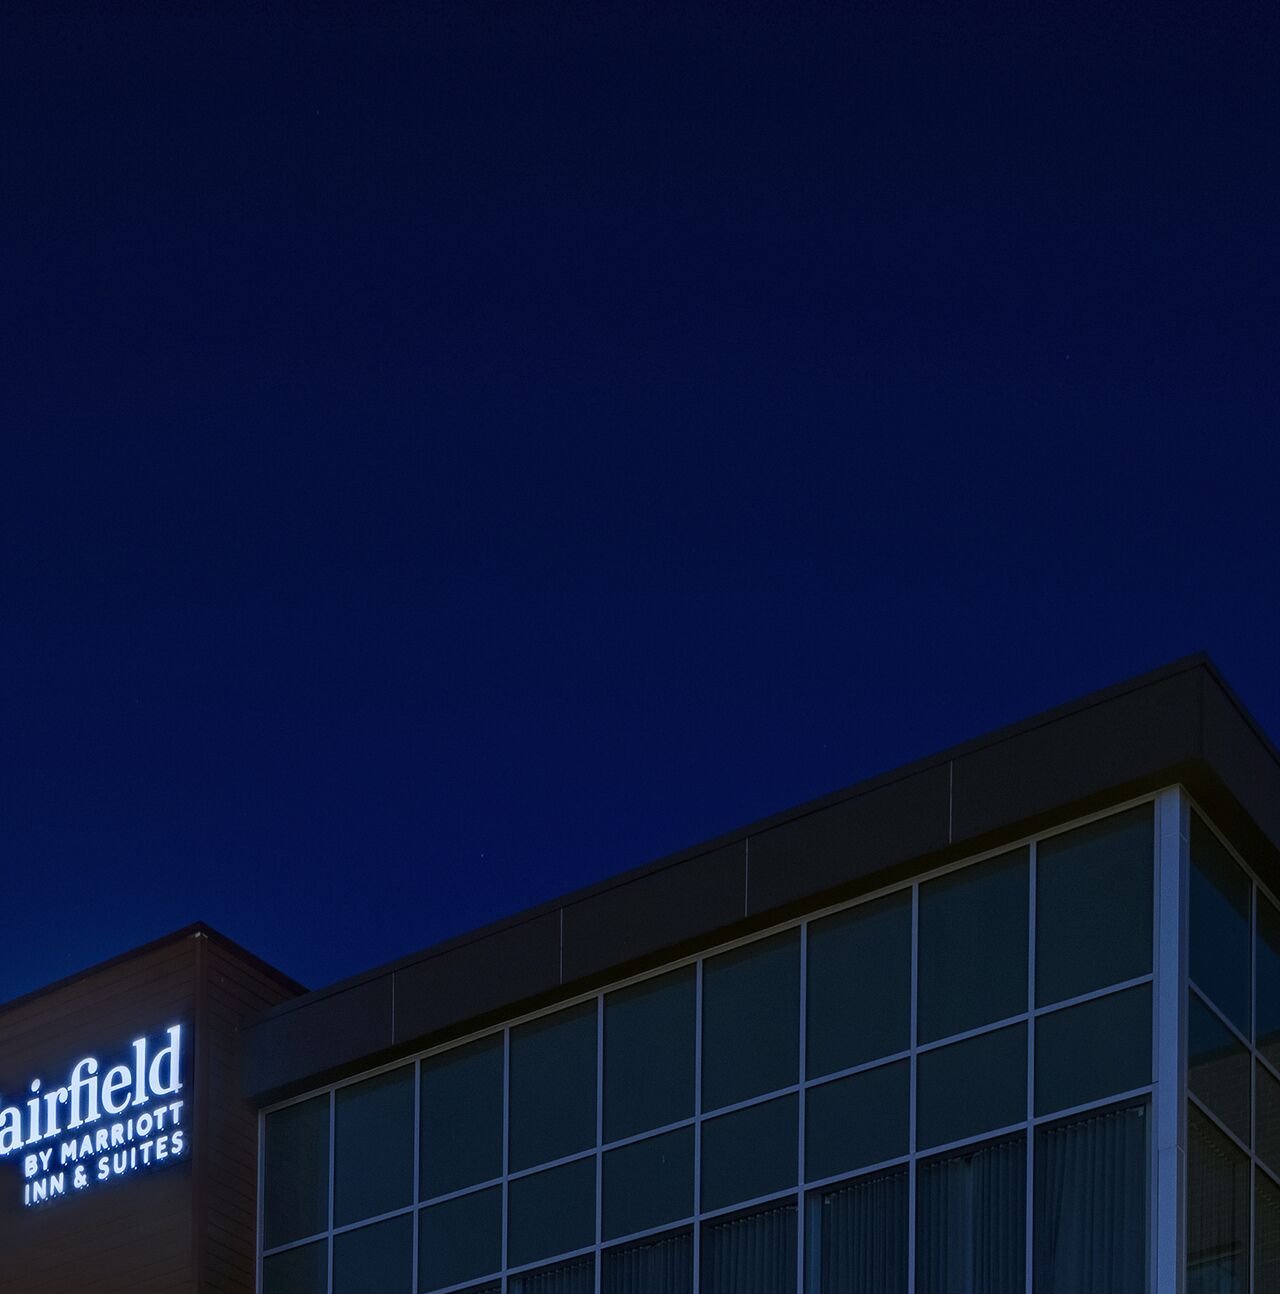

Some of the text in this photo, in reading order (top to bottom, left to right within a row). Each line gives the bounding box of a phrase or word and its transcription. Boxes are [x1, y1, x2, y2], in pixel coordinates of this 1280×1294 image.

[24, 1101, 184, 1178] BY MARRIOTT
[24, 1130, 184, 1206] INN & SUITES
